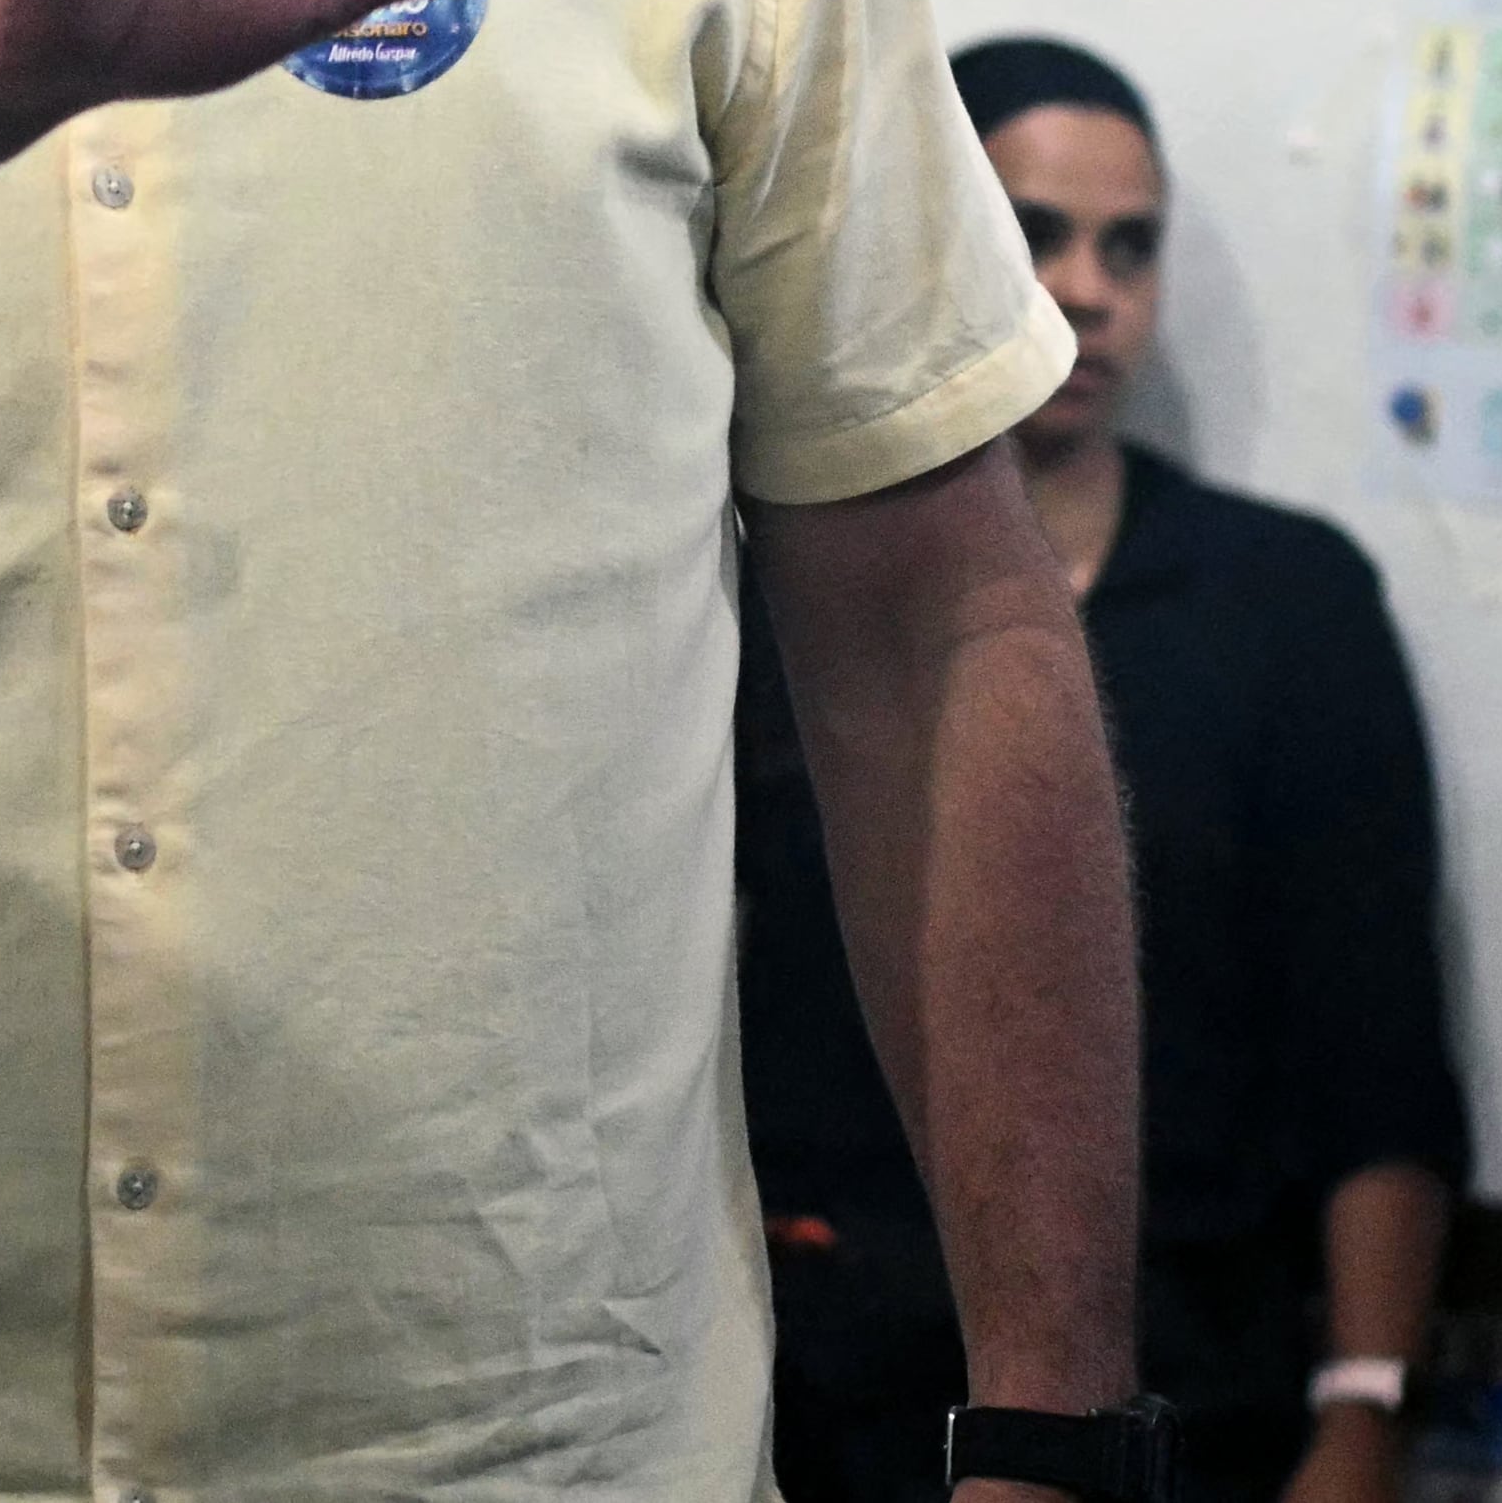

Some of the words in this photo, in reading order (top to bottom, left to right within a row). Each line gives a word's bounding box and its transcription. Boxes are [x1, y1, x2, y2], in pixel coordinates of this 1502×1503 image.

[336, 21, 428, 37] sonaro
[328, 42, 374, 62] Alfredo
[375, 41, 418, 61] Gaspar
